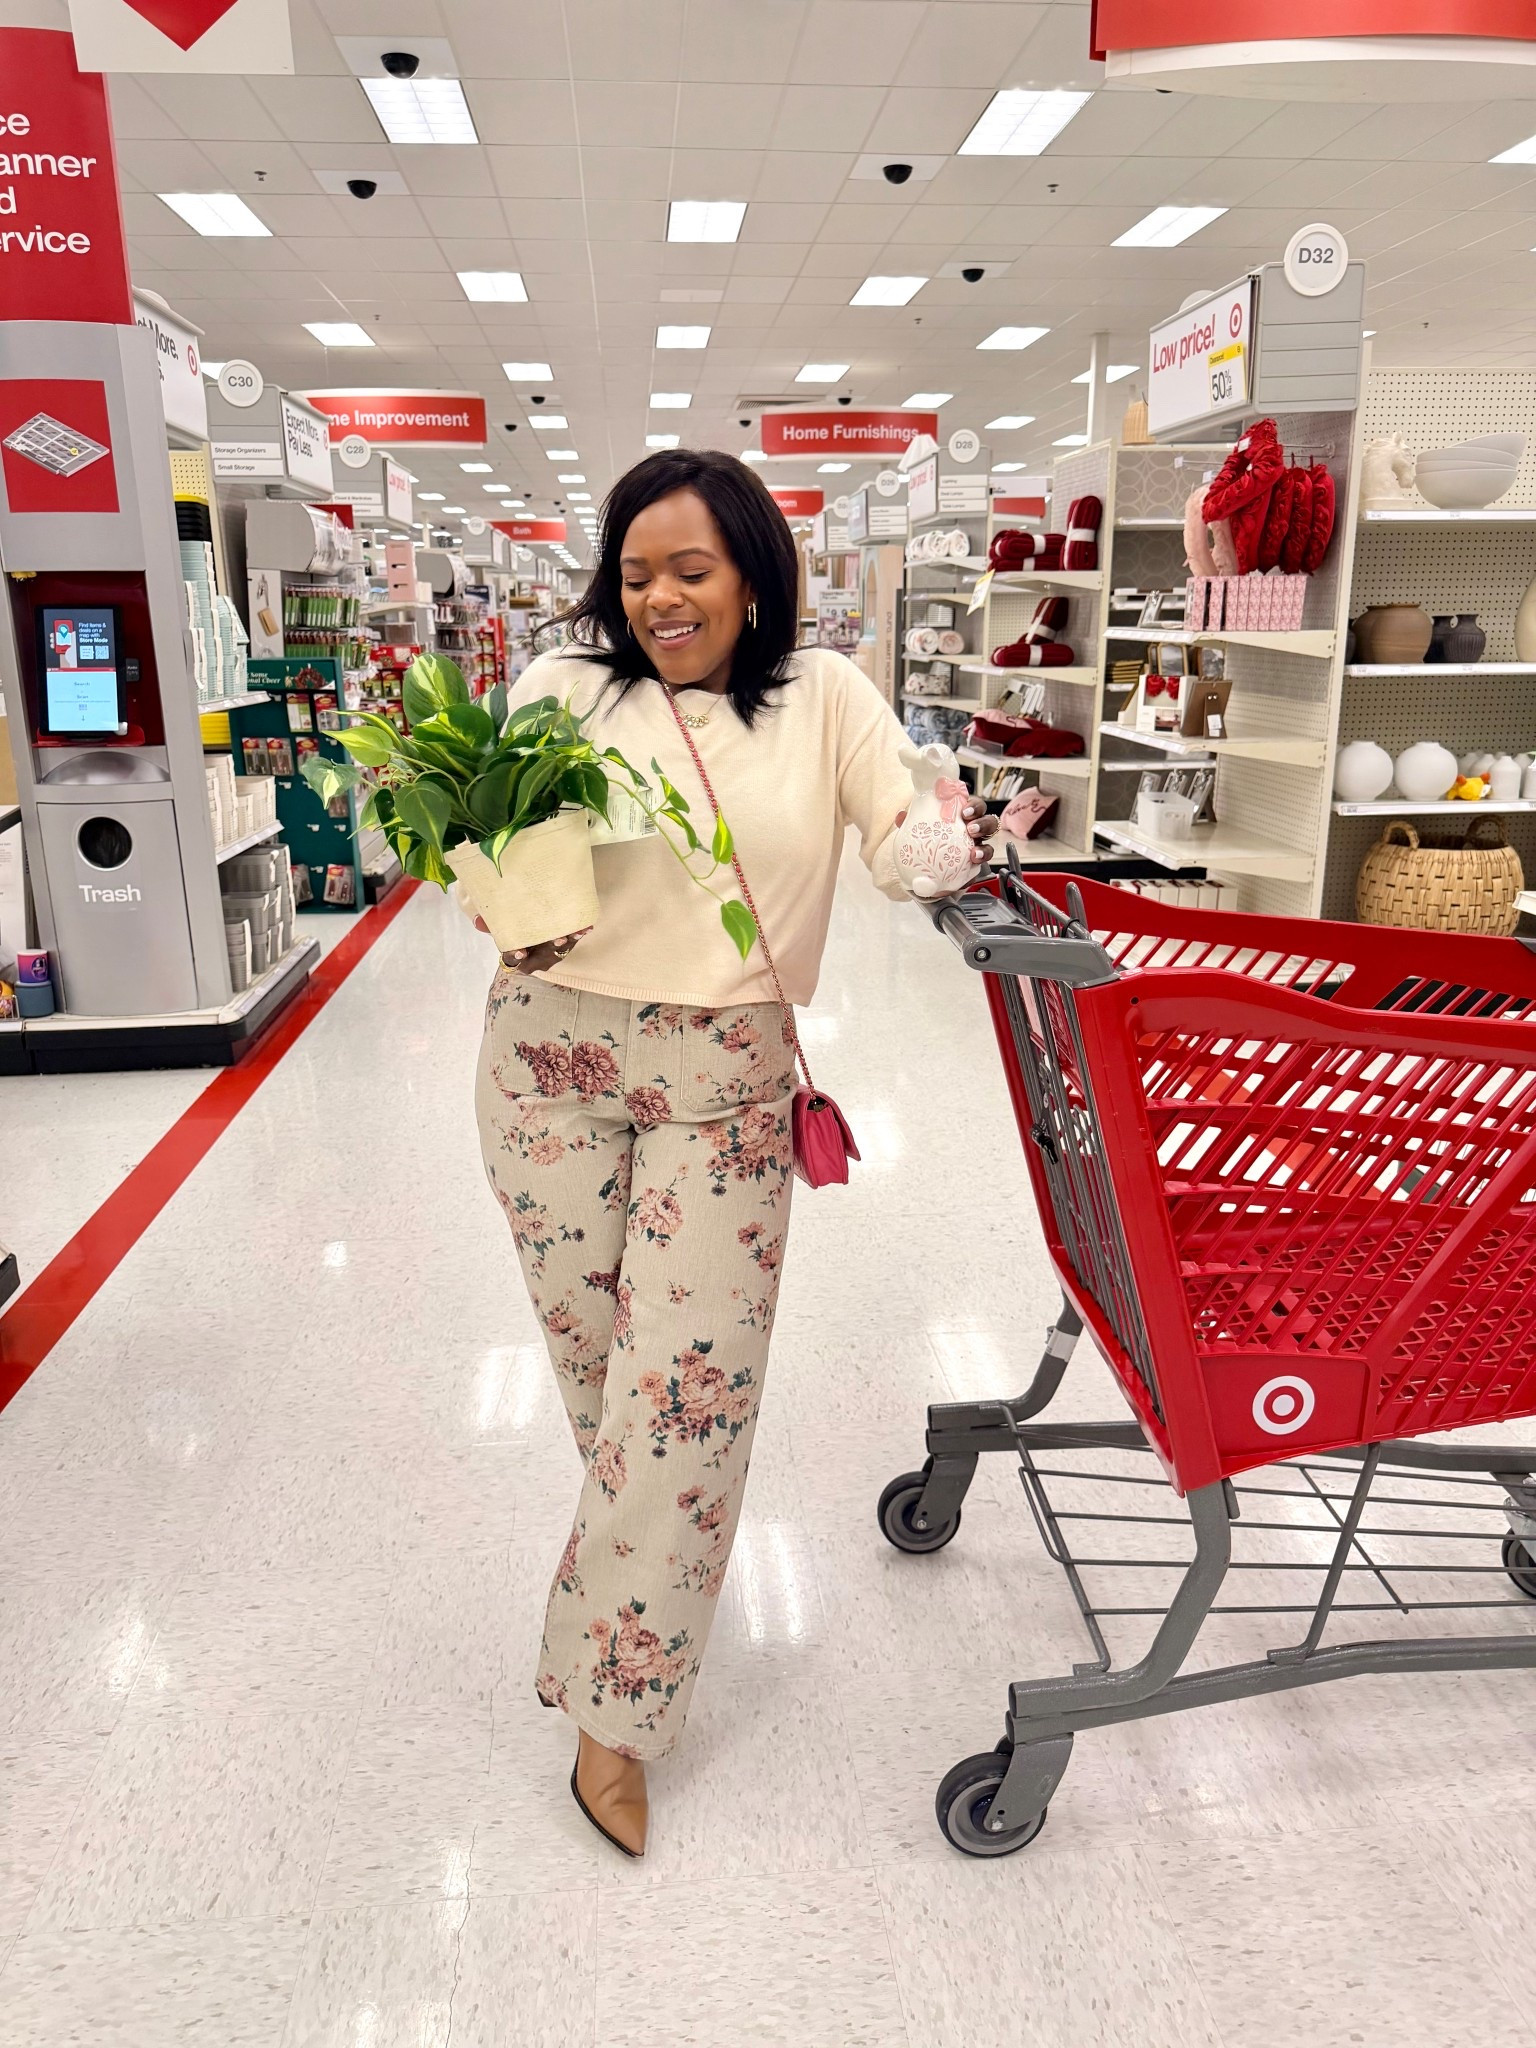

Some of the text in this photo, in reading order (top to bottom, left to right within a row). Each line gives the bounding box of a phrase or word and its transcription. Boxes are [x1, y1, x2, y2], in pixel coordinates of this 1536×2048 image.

[1298, 247, 1335, 264] D32
[1153, 314, 1216, 374] Low price!
[228, 376, 253, 387] C30
[286, 407, 305, 435] Expect
[354, 410, 470, 429] Improvement
[288, 429, 299, 456] Pay
[782, 424, 919, 443] Home Furnishings
[345, 445, 364, 454] C28
[78, 884, 142, 902] Trash
